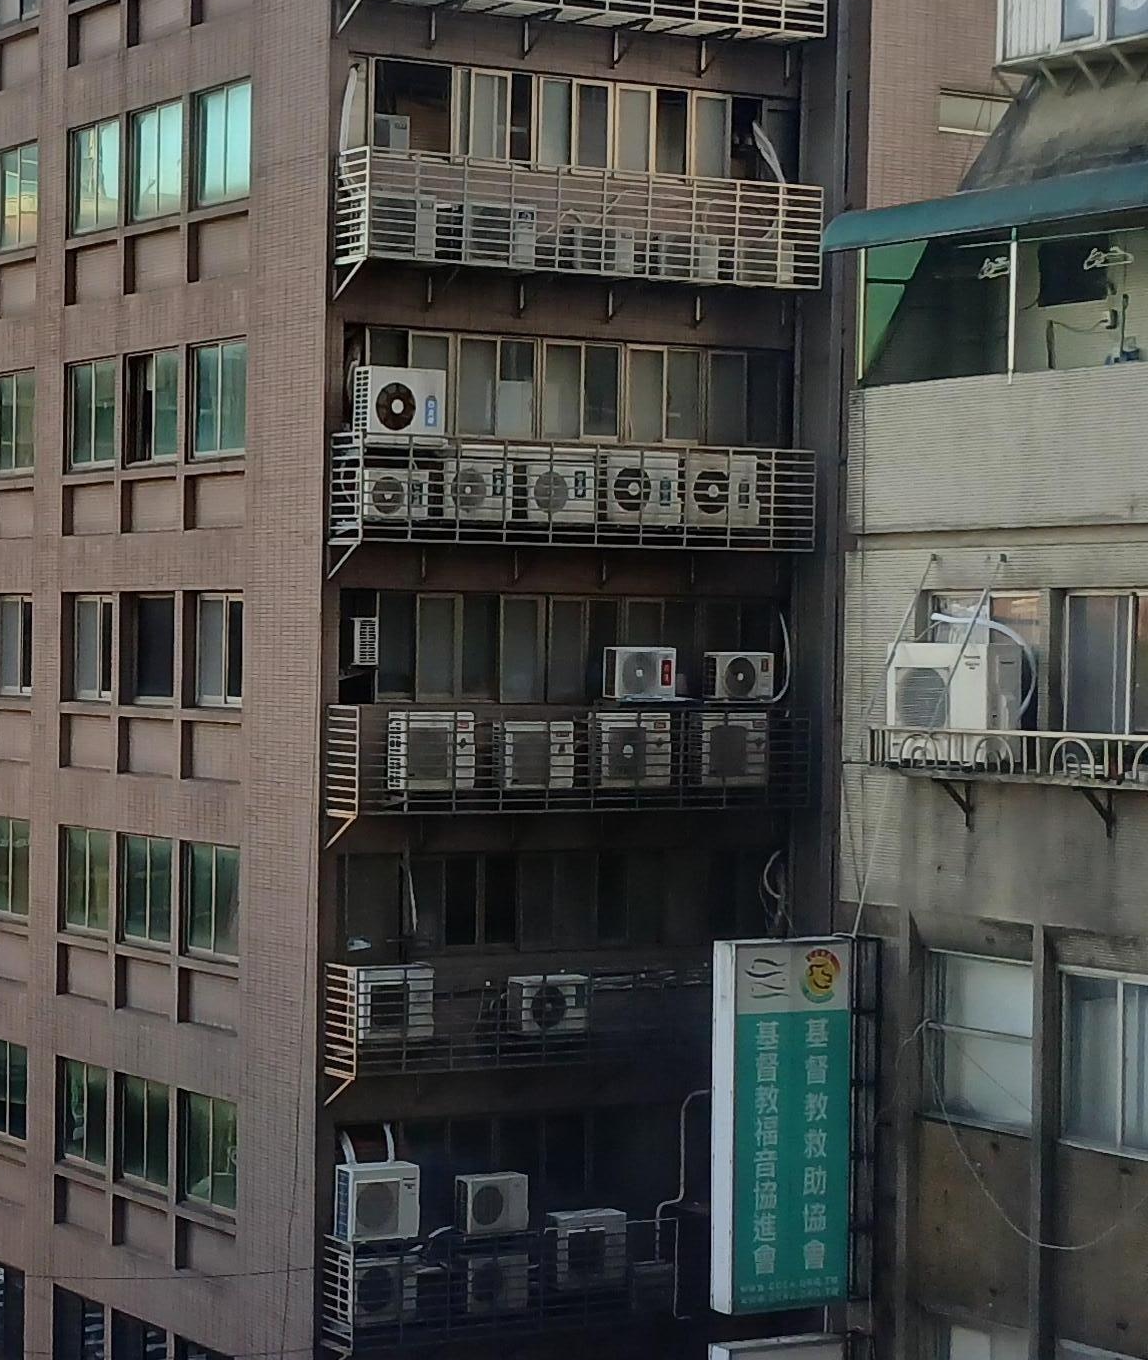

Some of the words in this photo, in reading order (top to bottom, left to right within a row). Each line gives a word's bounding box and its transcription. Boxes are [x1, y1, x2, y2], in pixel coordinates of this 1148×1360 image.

[753, 1020, 780, 1276] 基督教福音協進會
[803, 1017, 829, 1271] 基督教救助協會
